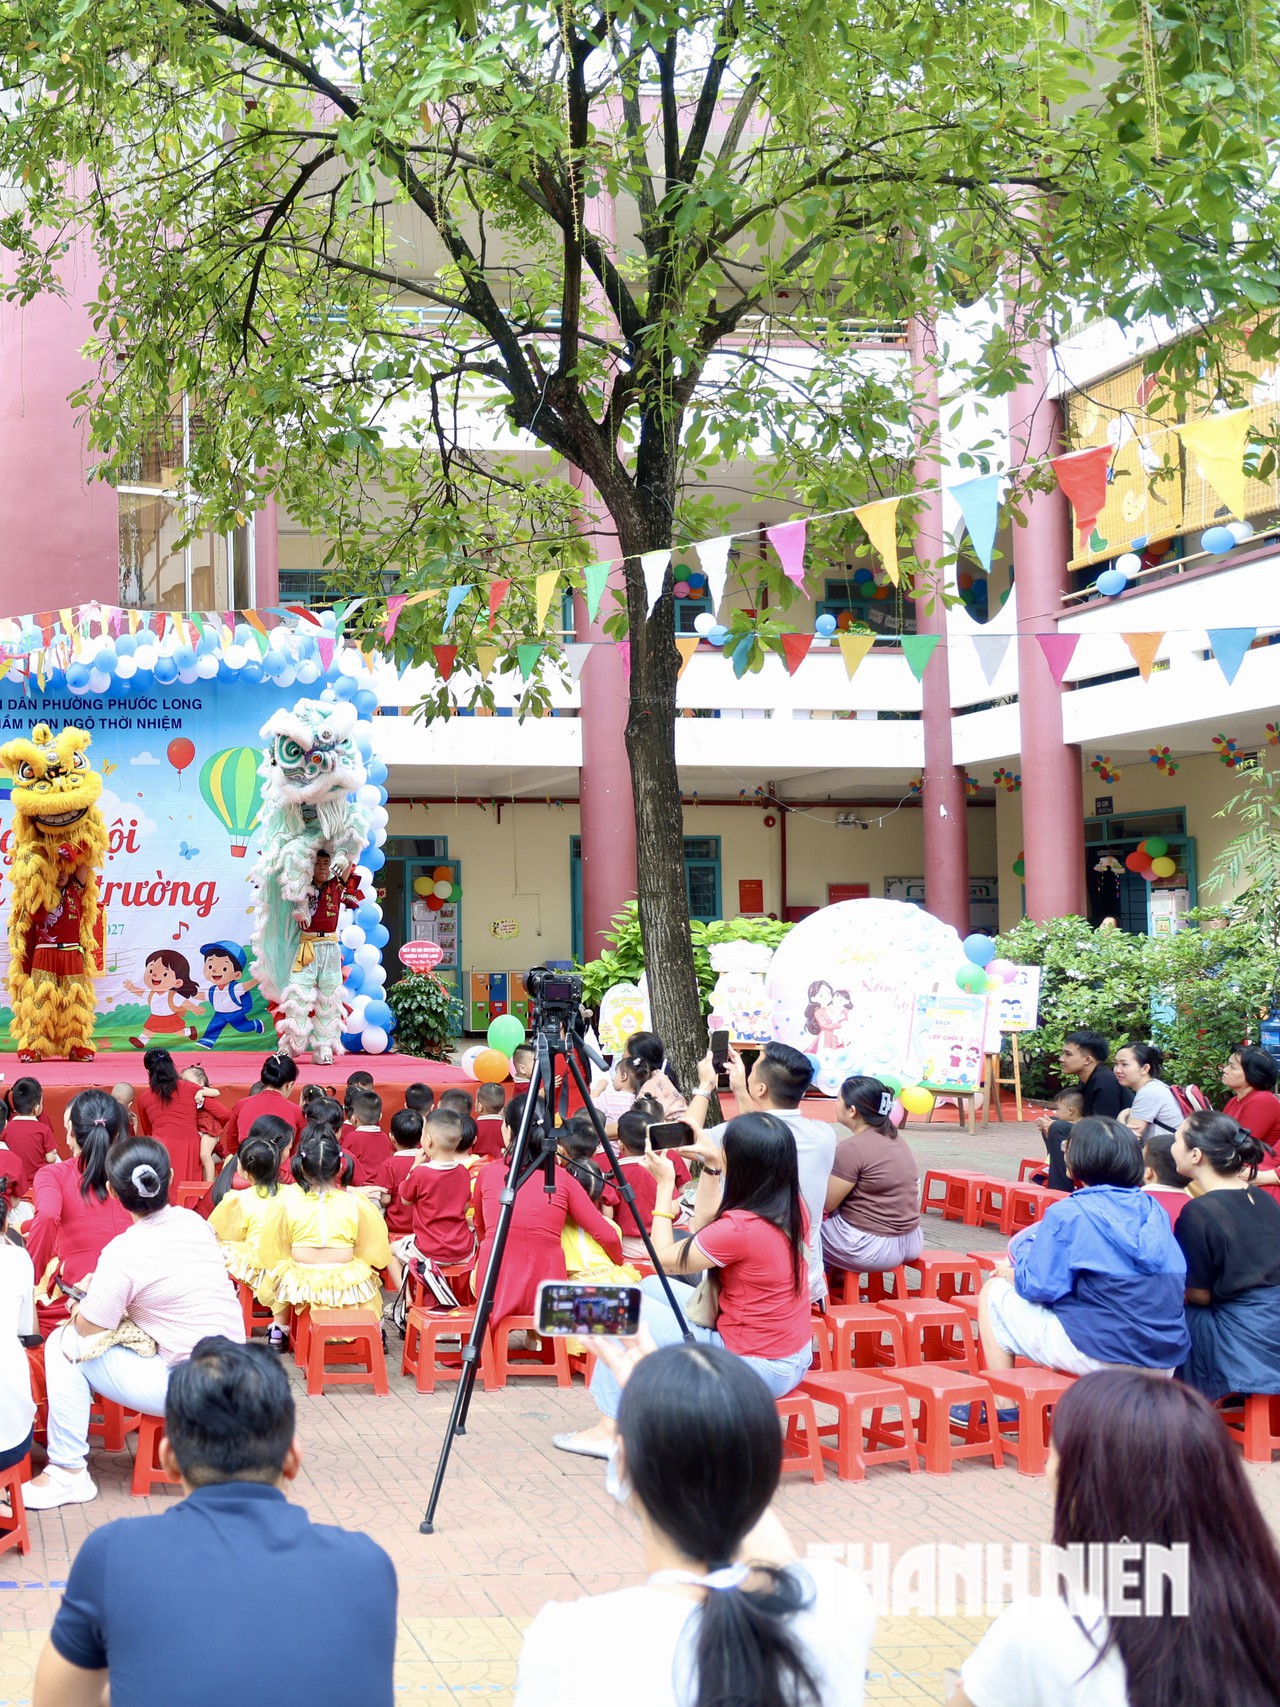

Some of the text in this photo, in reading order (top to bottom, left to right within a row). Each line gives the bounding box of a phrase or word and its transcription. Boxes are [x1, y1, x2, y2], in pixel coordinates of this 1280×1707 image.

[8, 697, 38, 710] DÂN
[42, 696, 103, 711] PHƯỜNG
[108, 696, 158, 710] PHƯỚC
[162, 699, 202, 710] LONG
[63, 716, 95, 730] NGÔ
[99, 716, 132, 729] THỜI
[137, 715, 182, 731] NHIỆM
[106, 817, 140, 861] ội
[95, 870, 219, 917] trường
